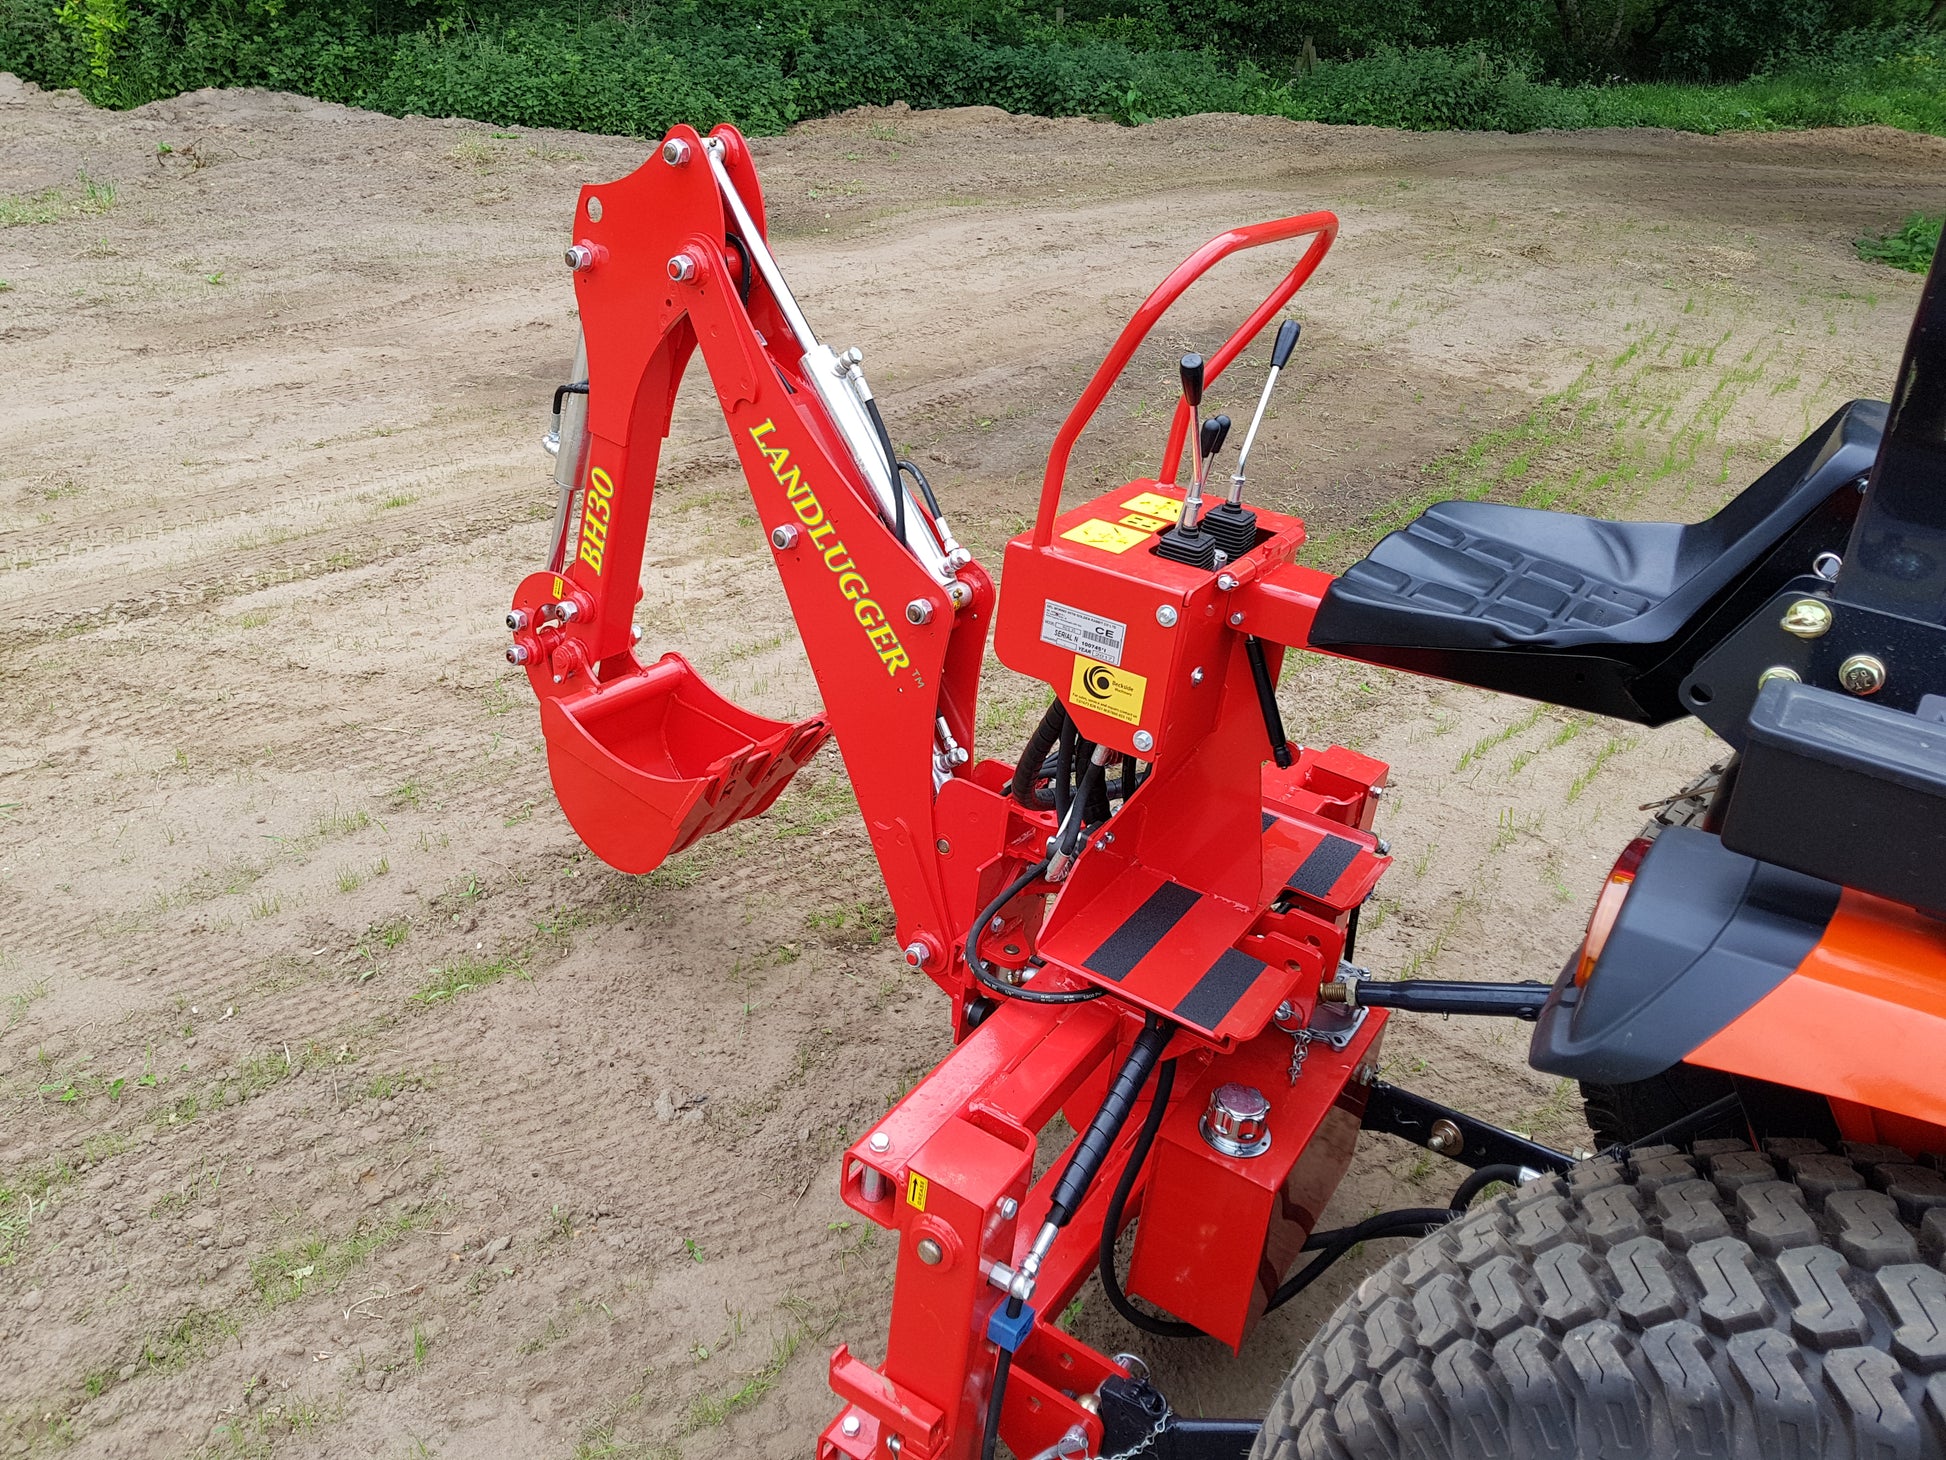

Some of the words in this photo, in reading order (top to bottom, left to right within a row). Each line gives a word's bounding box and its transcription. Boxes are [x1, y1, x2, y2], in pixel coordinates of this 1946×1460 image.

[579, 466, 615, 576] BH30
[749, 418, 909, 677] LANDLUGGER
[1054, 630, 1073, 641] SERIAL
[1095, 627, 1114, 638] CE
